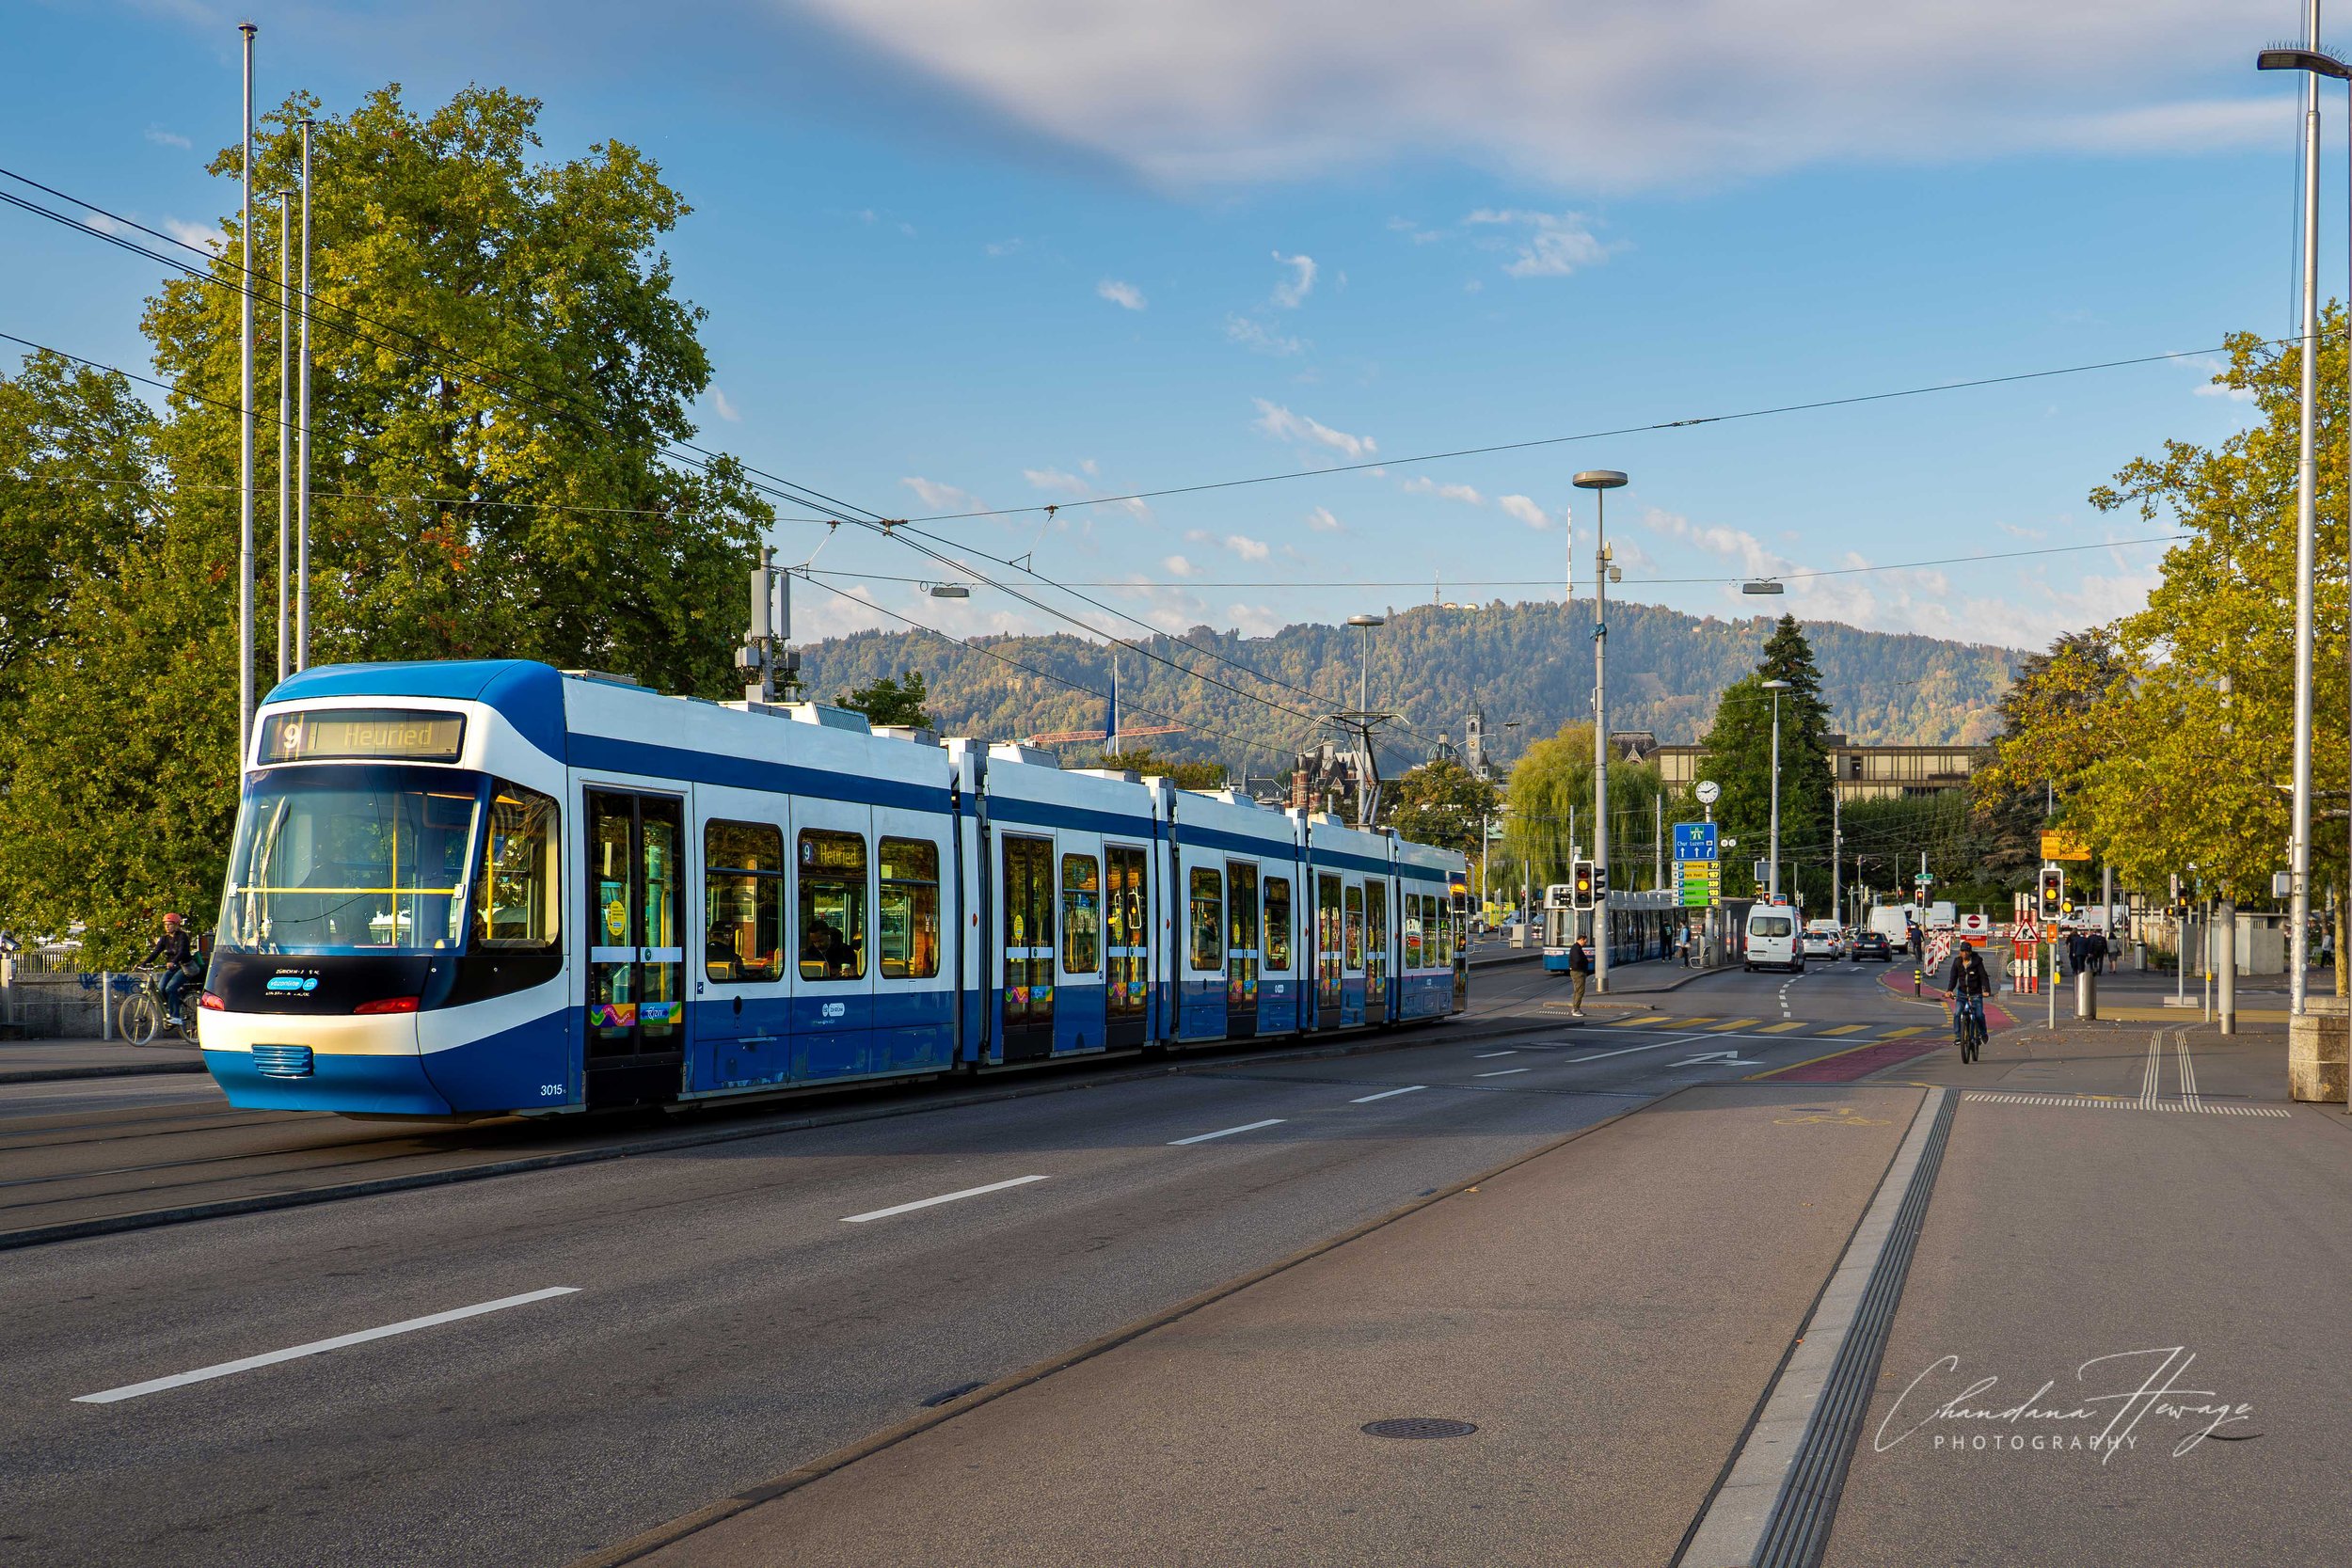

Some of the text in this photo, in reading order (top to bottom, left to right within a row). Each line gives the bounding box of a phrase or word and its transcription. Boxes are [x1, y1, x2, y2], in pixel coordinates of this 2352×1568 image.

[284, 722, 433, 749] 9 Heuried
[803, 844, 857, 865] 9 Heuried
[540, 1084, 563, 1096] 3015
